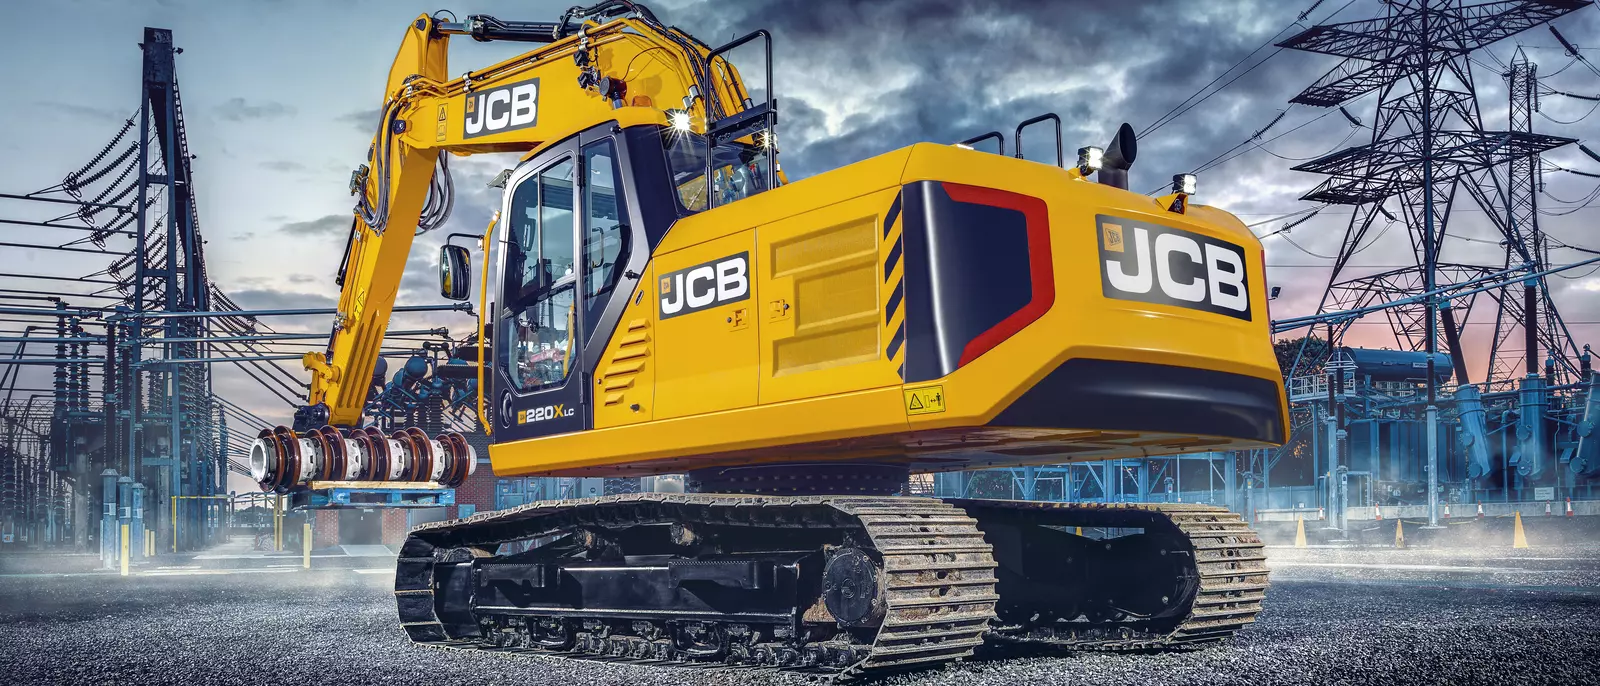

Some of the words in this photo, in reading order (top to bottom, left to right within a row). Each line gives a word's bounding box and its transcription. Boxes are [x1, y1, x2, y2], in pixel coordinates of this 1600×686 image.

[466, 84, 536, 134] JCB
[662, 258, 747, 314] JCB
[1106, 227, 1247, 312] JCB
